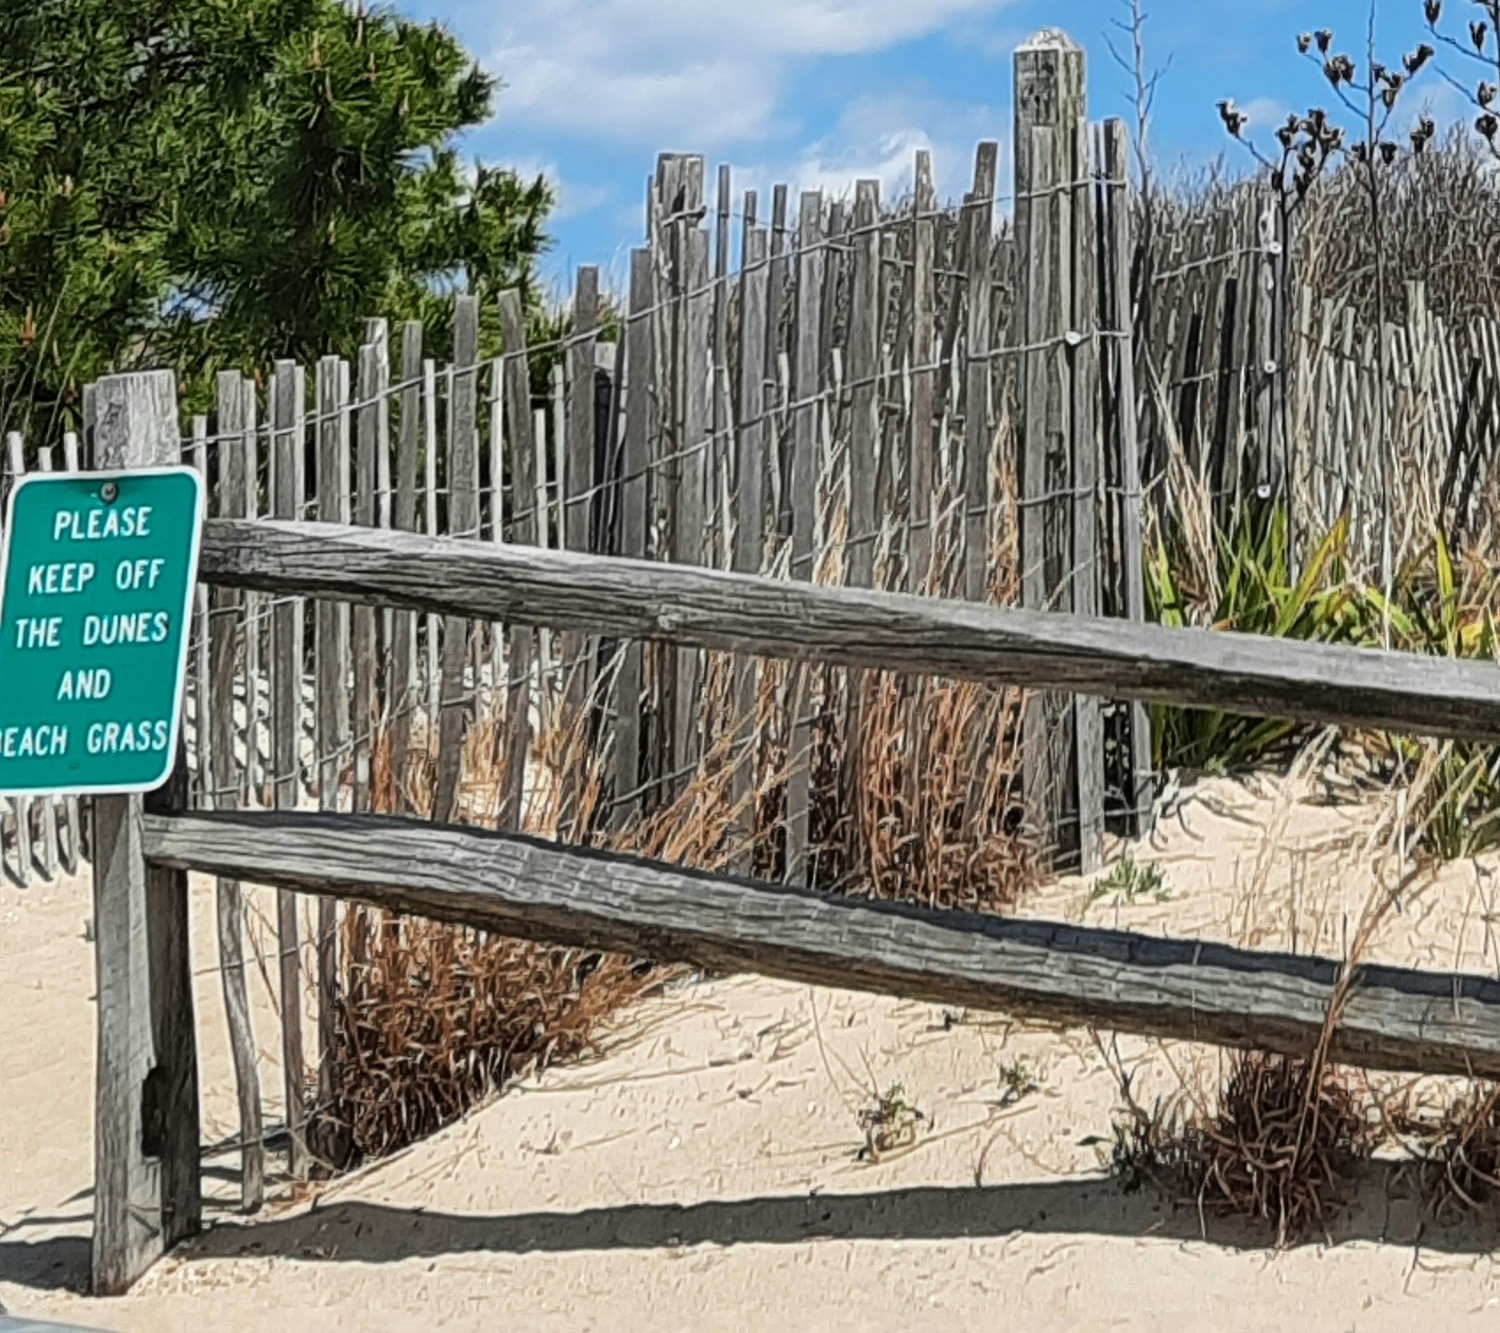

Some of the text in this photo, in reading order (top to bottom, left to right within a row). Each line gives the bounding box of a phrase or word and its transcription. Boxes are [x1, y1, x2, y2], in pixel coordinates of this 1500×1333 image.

[54, 506, 153, 540] PLEASE
[28, 558, 165, 594] KEEP OFF
[15, 612, 169, 648] THE DUNES
[57, 669, 112, 700] AND
[0, 720, 168, 757] EACH GRASS
